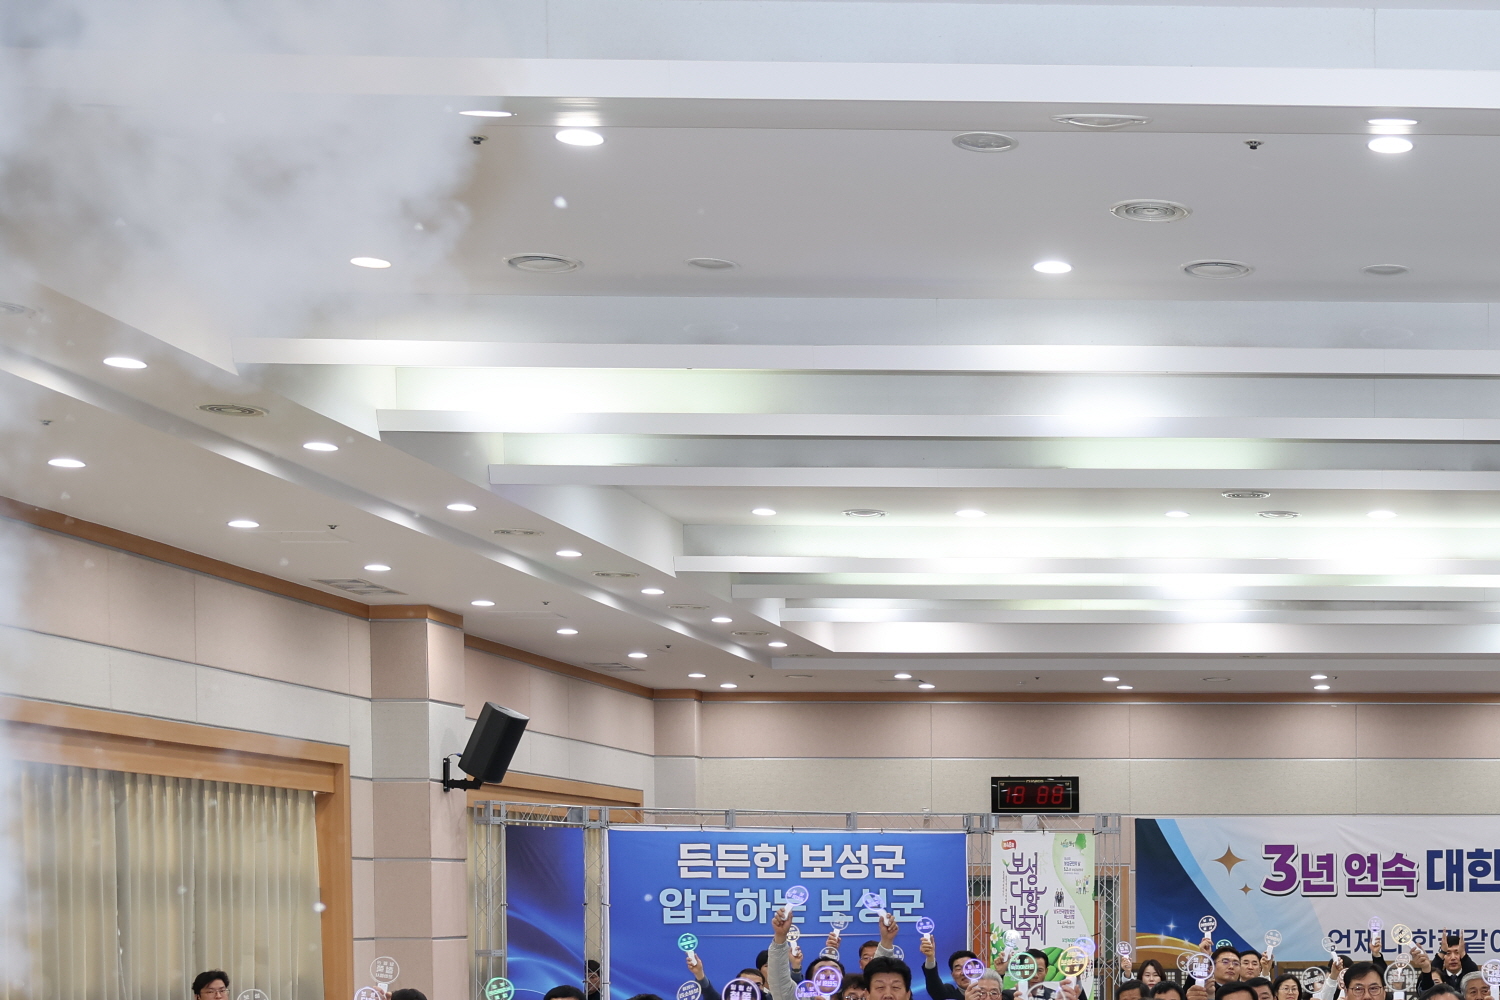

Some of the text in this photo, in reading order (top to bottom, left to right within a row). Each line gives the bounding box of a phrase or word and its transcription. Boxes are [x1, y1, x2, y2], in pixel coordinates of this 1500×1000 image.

[677, 843, 905, 879] 든든한 보성군
[1006, 852, 1038, 885] 보성
[1261, 843, 1336, 895] 3년
[1343, 851, 1418, 894] 연속
[659, 888, 925, 924] 압도하는 보성군
[1010, 878, 1047, 913] 다향
[1000, 906, 1047, 951] 대축제
